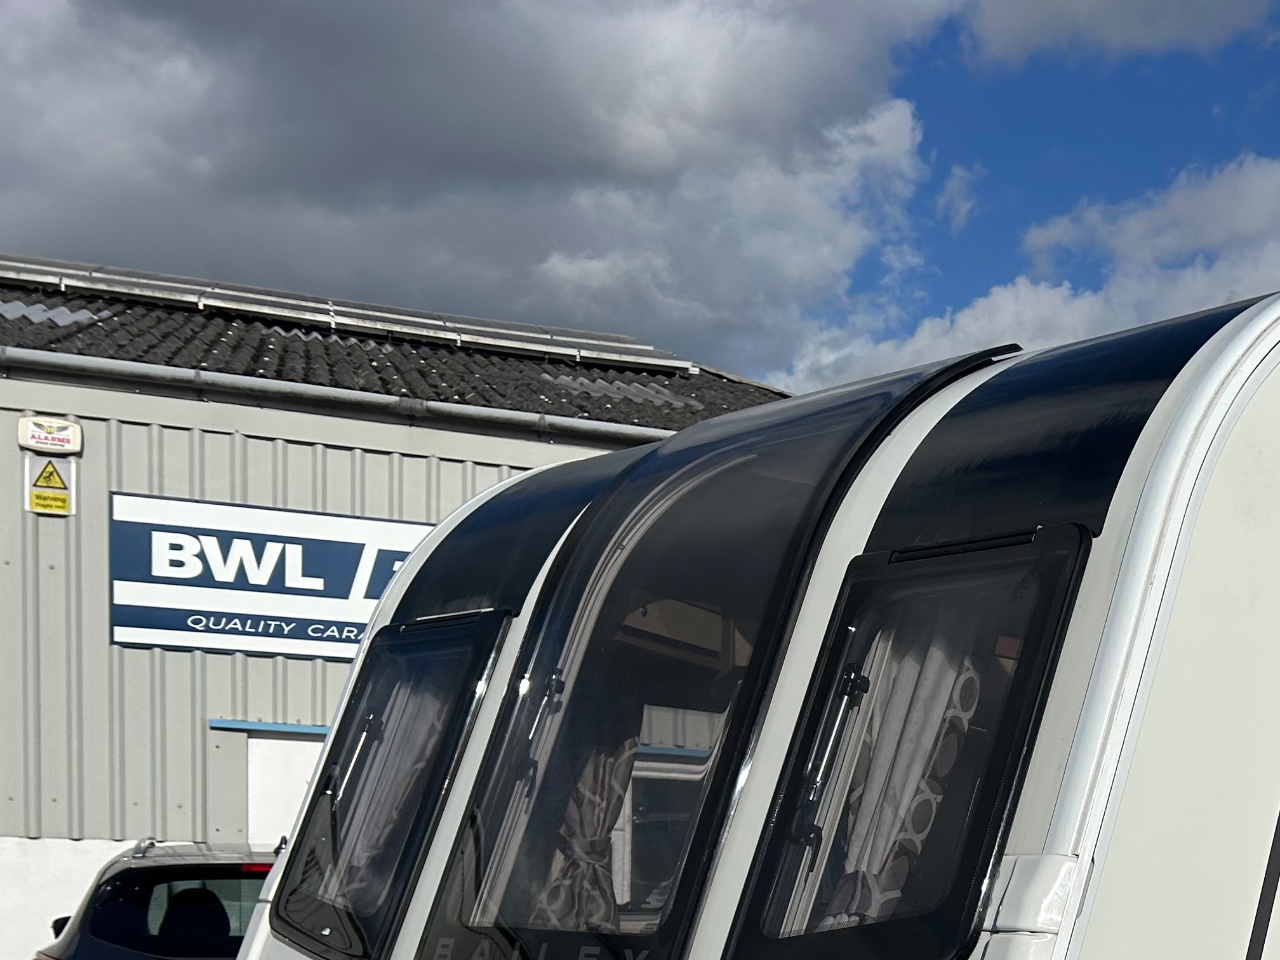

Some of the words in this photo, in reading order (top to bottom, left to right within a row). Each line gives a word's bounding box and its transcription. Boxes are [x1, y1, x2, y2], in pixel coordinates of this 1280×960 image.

[34, 494, 67, 504] Warning
[151, 531, 324, 590] BWL
[187, 615, 297, 635] QUALITY
[307, 624, 366, 640] CAR
